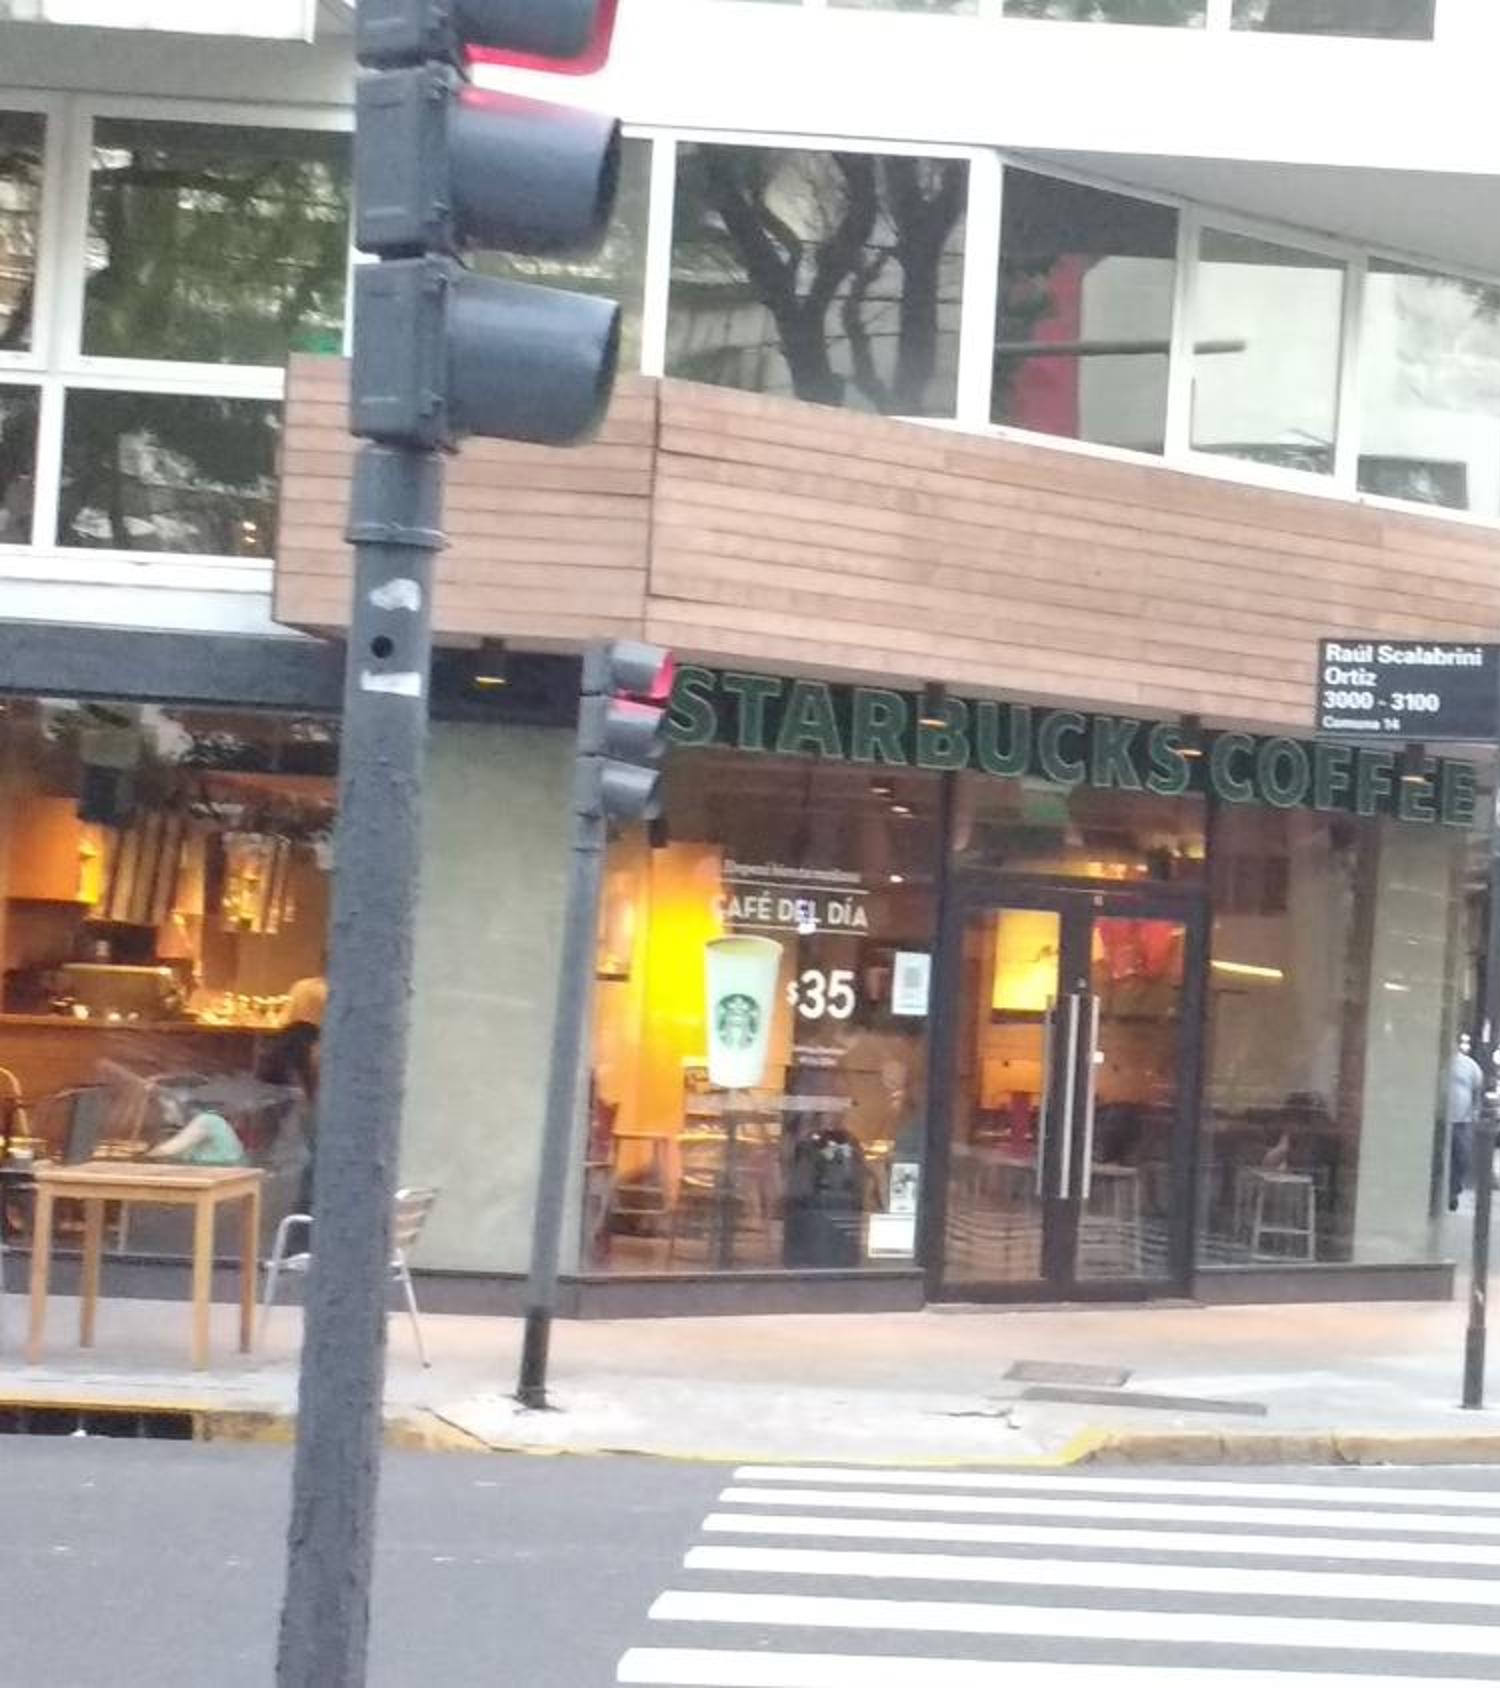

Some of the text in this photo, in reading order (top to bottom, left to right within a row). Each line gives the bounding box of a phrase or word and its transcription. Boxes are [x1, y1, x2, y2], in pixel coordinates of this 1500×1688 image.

[1325, 643, 1483, 666] Raúl Scalabrini
[1324, 666, 1377, 687] Ortiz
[1322, 690, 1374, 710] 3000
[1390, 692, 1440, 713] 3100
[668, 665, 1474, 826] STARBUCKS COFFEE
[777, 900, 821, 924] DEL
[827, 897, 869, 927] DÍA
